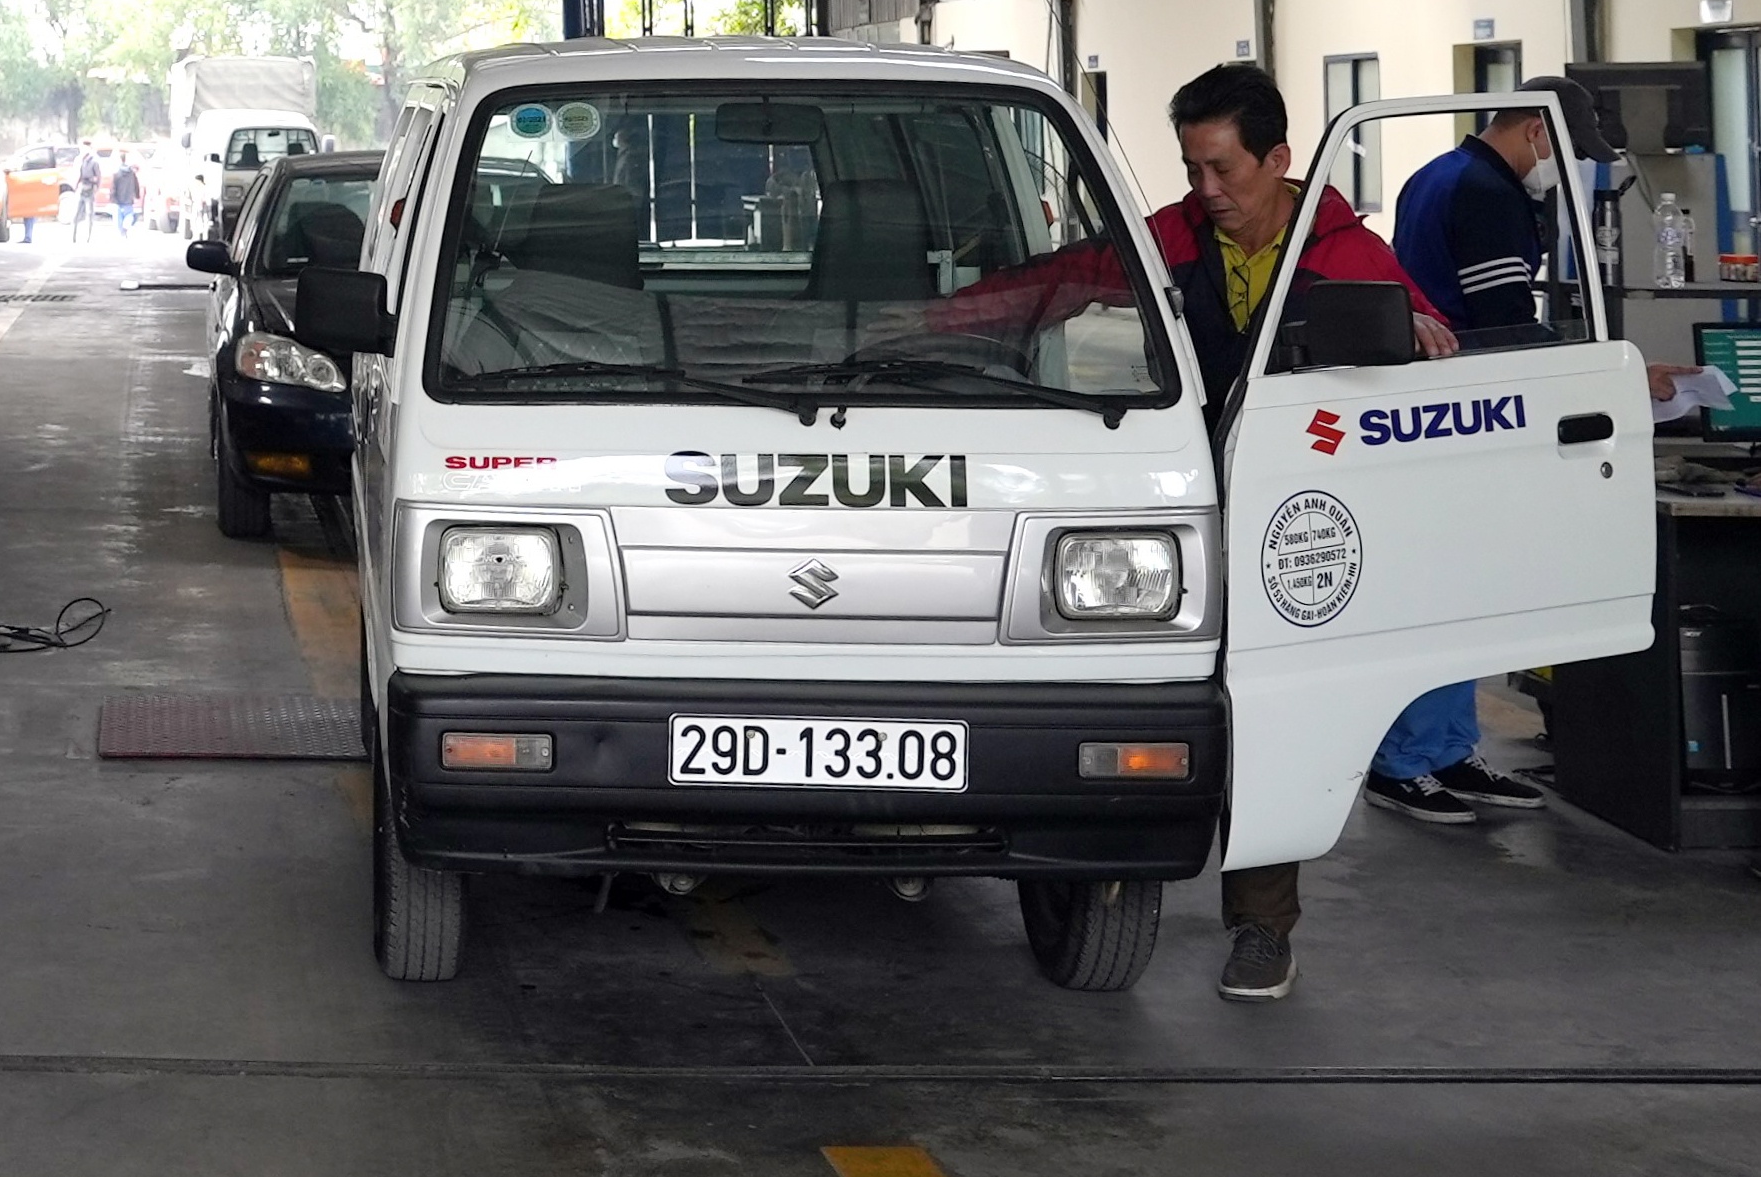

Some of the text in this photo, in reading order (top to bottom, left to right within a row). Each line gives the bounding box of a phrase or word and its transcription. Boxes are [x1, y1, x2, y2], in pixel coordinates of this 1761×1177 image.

[1358, 394, 1527, 446] SUZUKI
[444, 456, 557, 470] SUPER
[664, 450, 968, 508] SUZUKI
[1304, 497, 1327, 512] ANH
[1284, 531, 1309, 546] 580KG
[1311, 527, 1336, 542] 740KG
[1294, 548, 1347, 568] 0936290572
[1316, 571, 1333, 589] 2N
[679, 724, 958, 781] 29D-133.08
